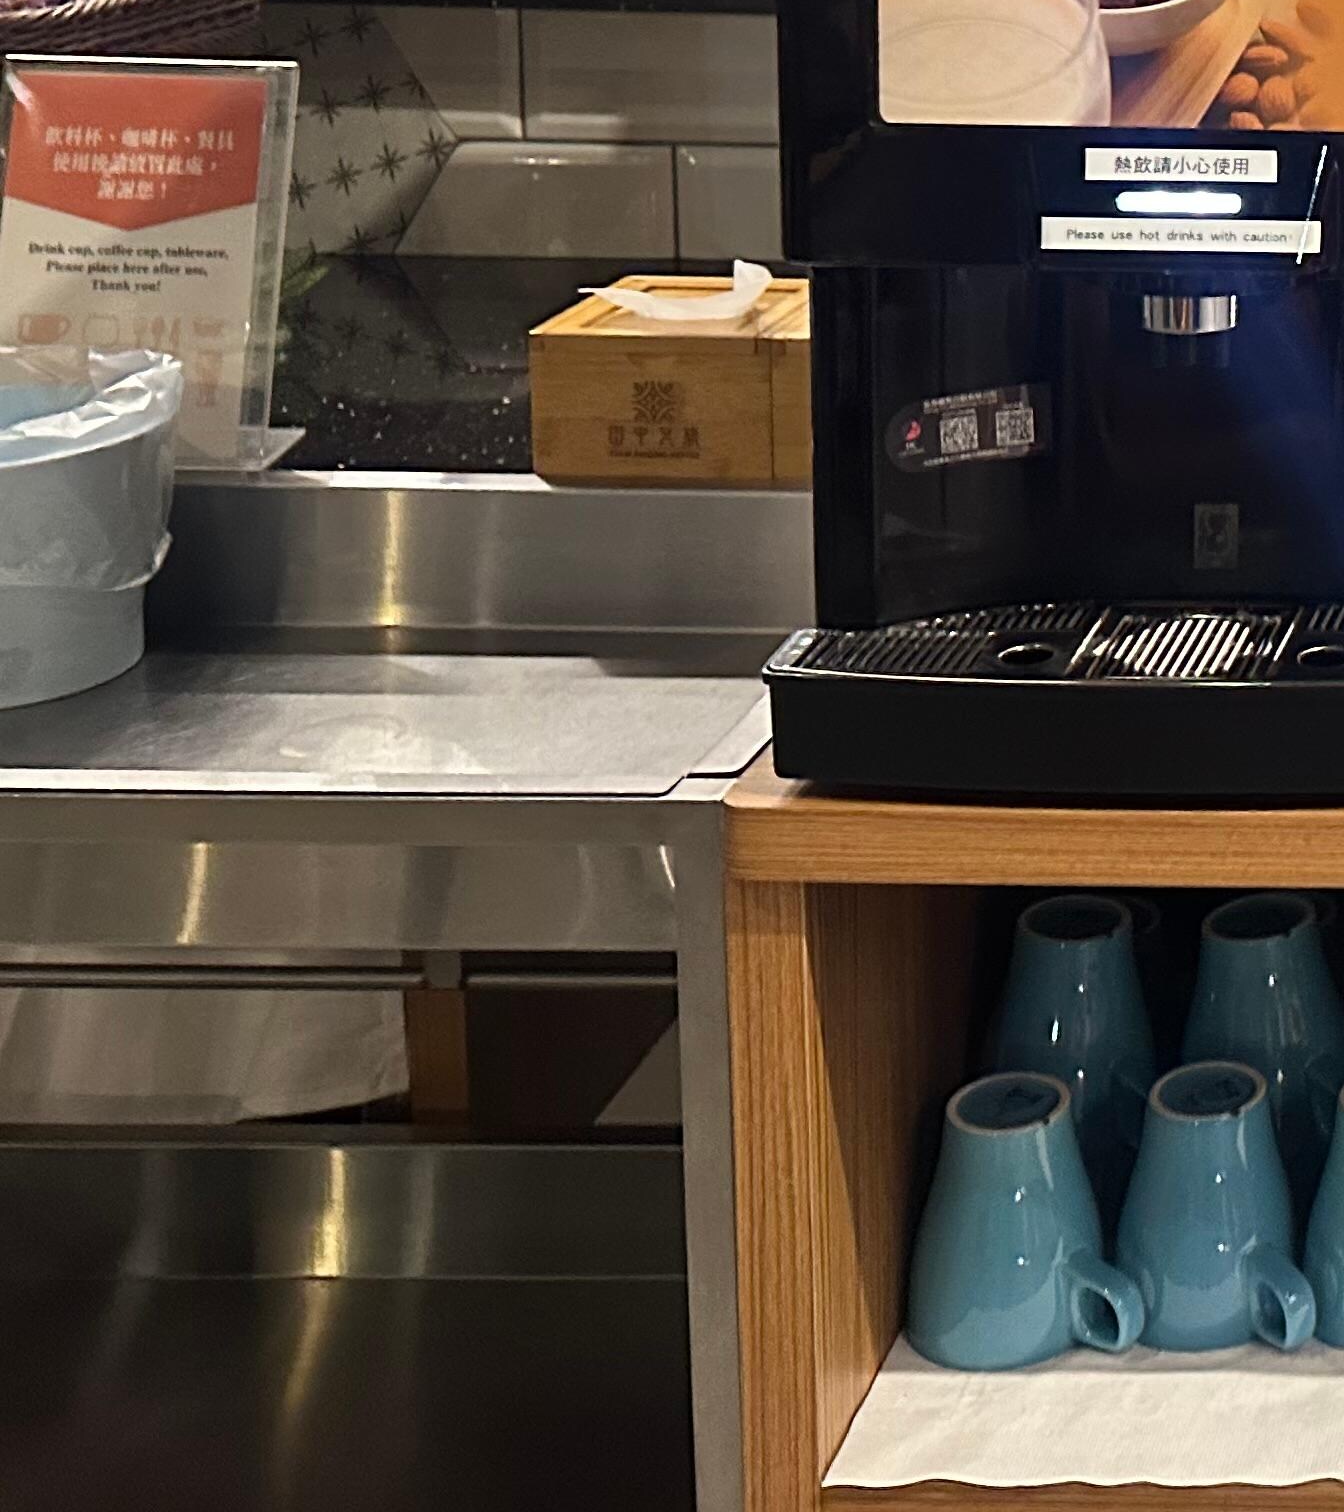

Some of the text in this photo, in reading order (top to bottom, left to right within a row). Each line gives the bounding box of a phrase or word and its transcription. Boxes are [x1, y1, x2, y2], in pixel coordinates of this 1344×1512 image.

[1114, 156, 1250, 176] 熱飲請小心使用
[1067, 229, 1105, 241] Please
[1111, 231, 1133, 240] use
[1139, 229, 1160, 241] hot
[1167, 230, 1202, 242] drinks
[1210, 231, 1237, 243] with
[29, 240, 229, 261] Drink cup, coffee cup, tableware,
[46, 259, 82, 273] Please
[86, 261, 119, 275] place
[123, 261, 150, 274] here
[153, 262, 181, 276] after
[91, 278, 161, 293] Thank you!
